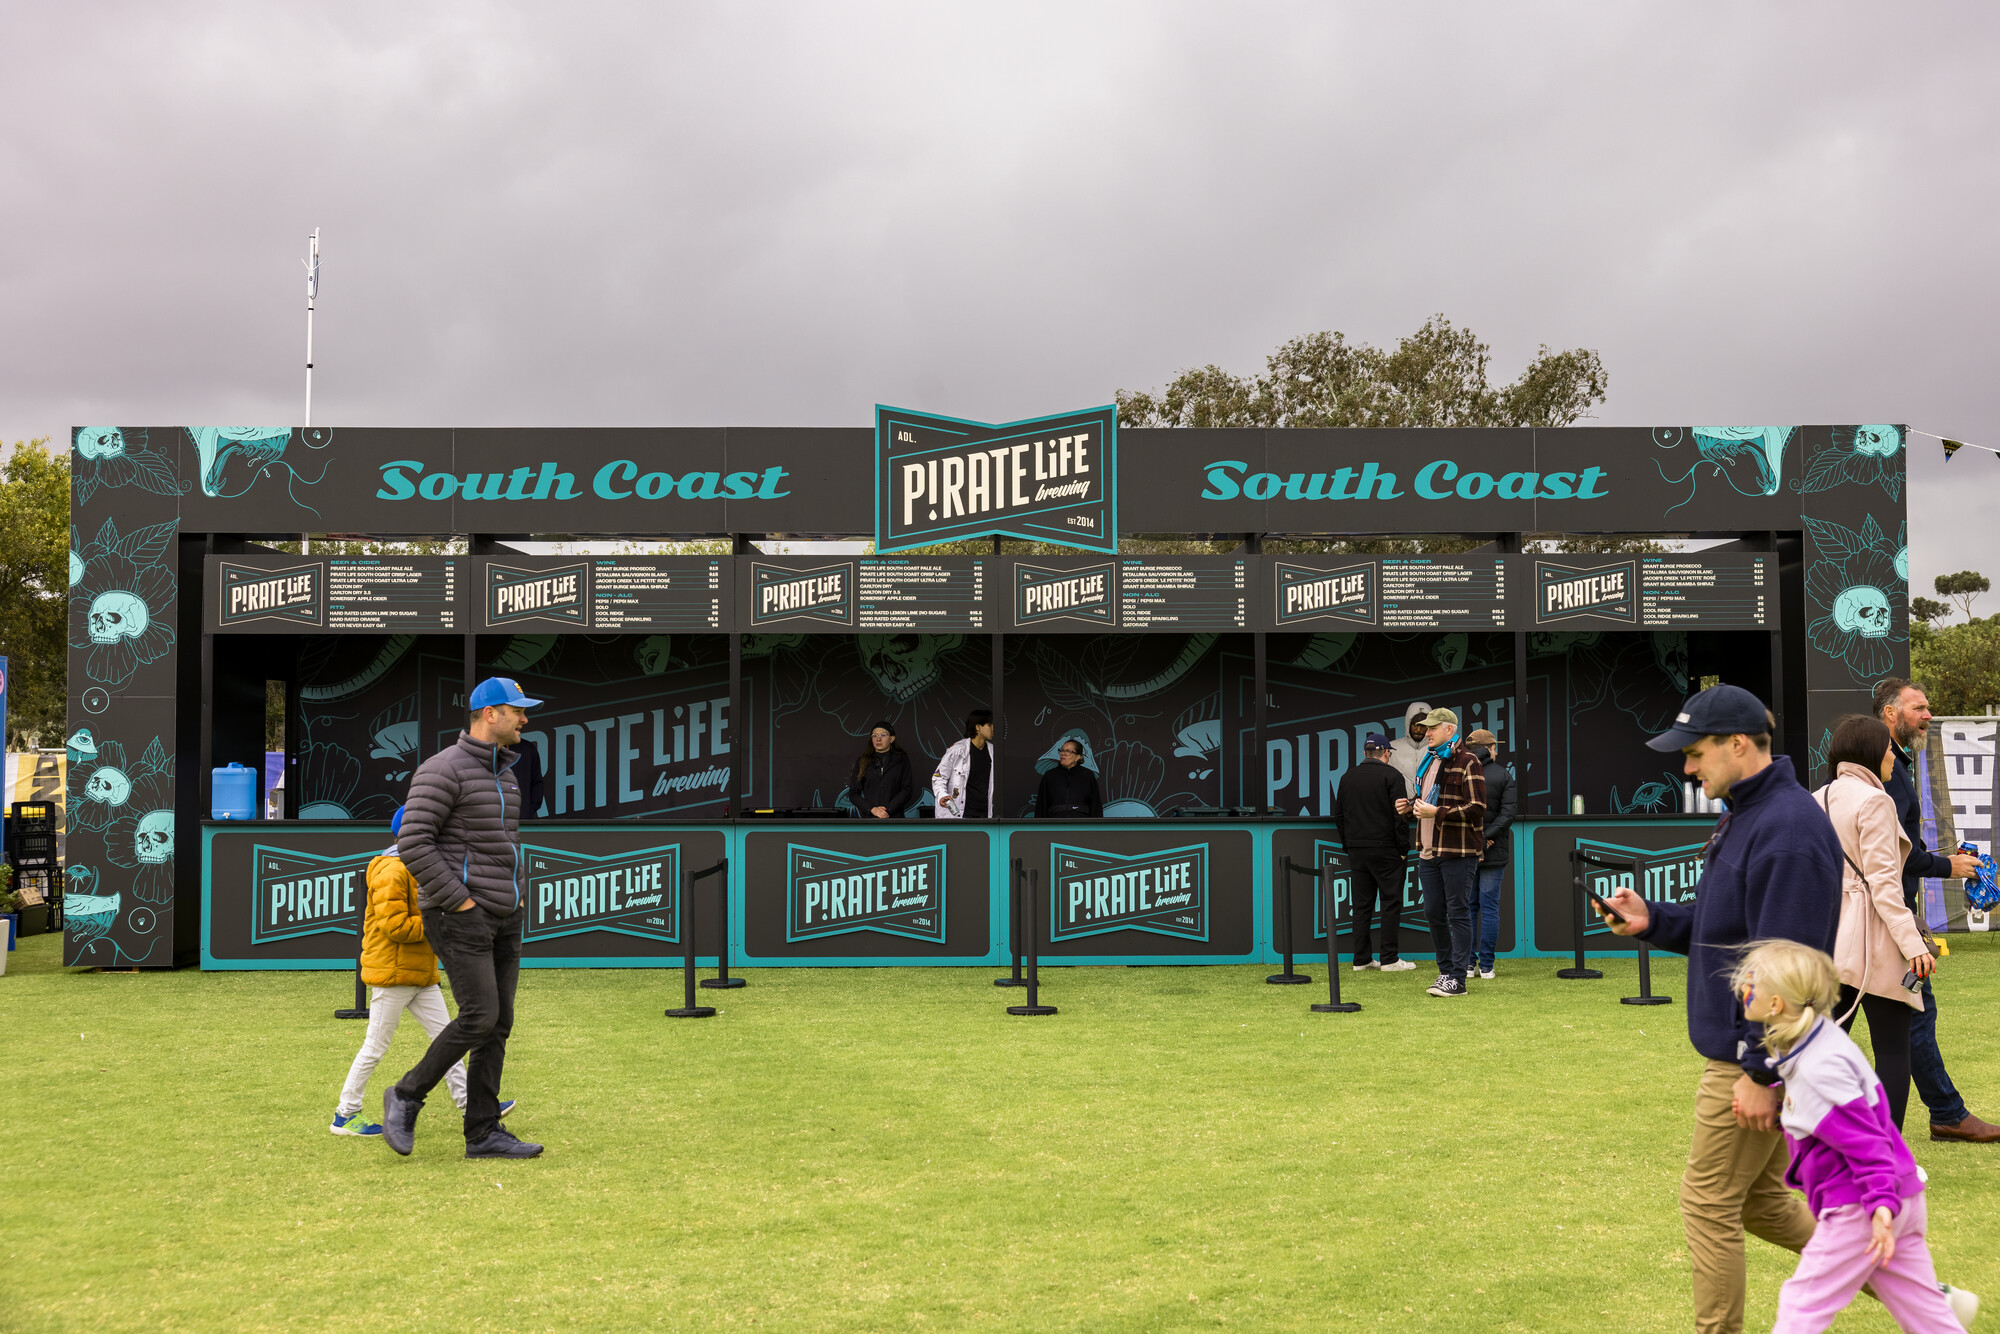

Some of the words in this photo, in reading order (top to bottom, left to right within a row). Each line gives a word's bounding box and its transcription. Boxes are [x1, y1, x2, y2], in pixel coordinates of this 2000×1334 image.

[898, 431, 916, 444] ADL.
[376, 460, 582, 500] South
[593, 460, 790, 500] Coast
[1201, 460, 1404, 500] South
[1414, 460, 1608, 500] Coast
[1035, 480, 1090, 502] brewing
[1076, 516, 1094, 528] 2014
[652, 765, 730, 797] brewing
[625, 893, 662, 908] brewing
[892, 894, 928, 908] brewing
[1155, 892, 1192, 907] brewing
